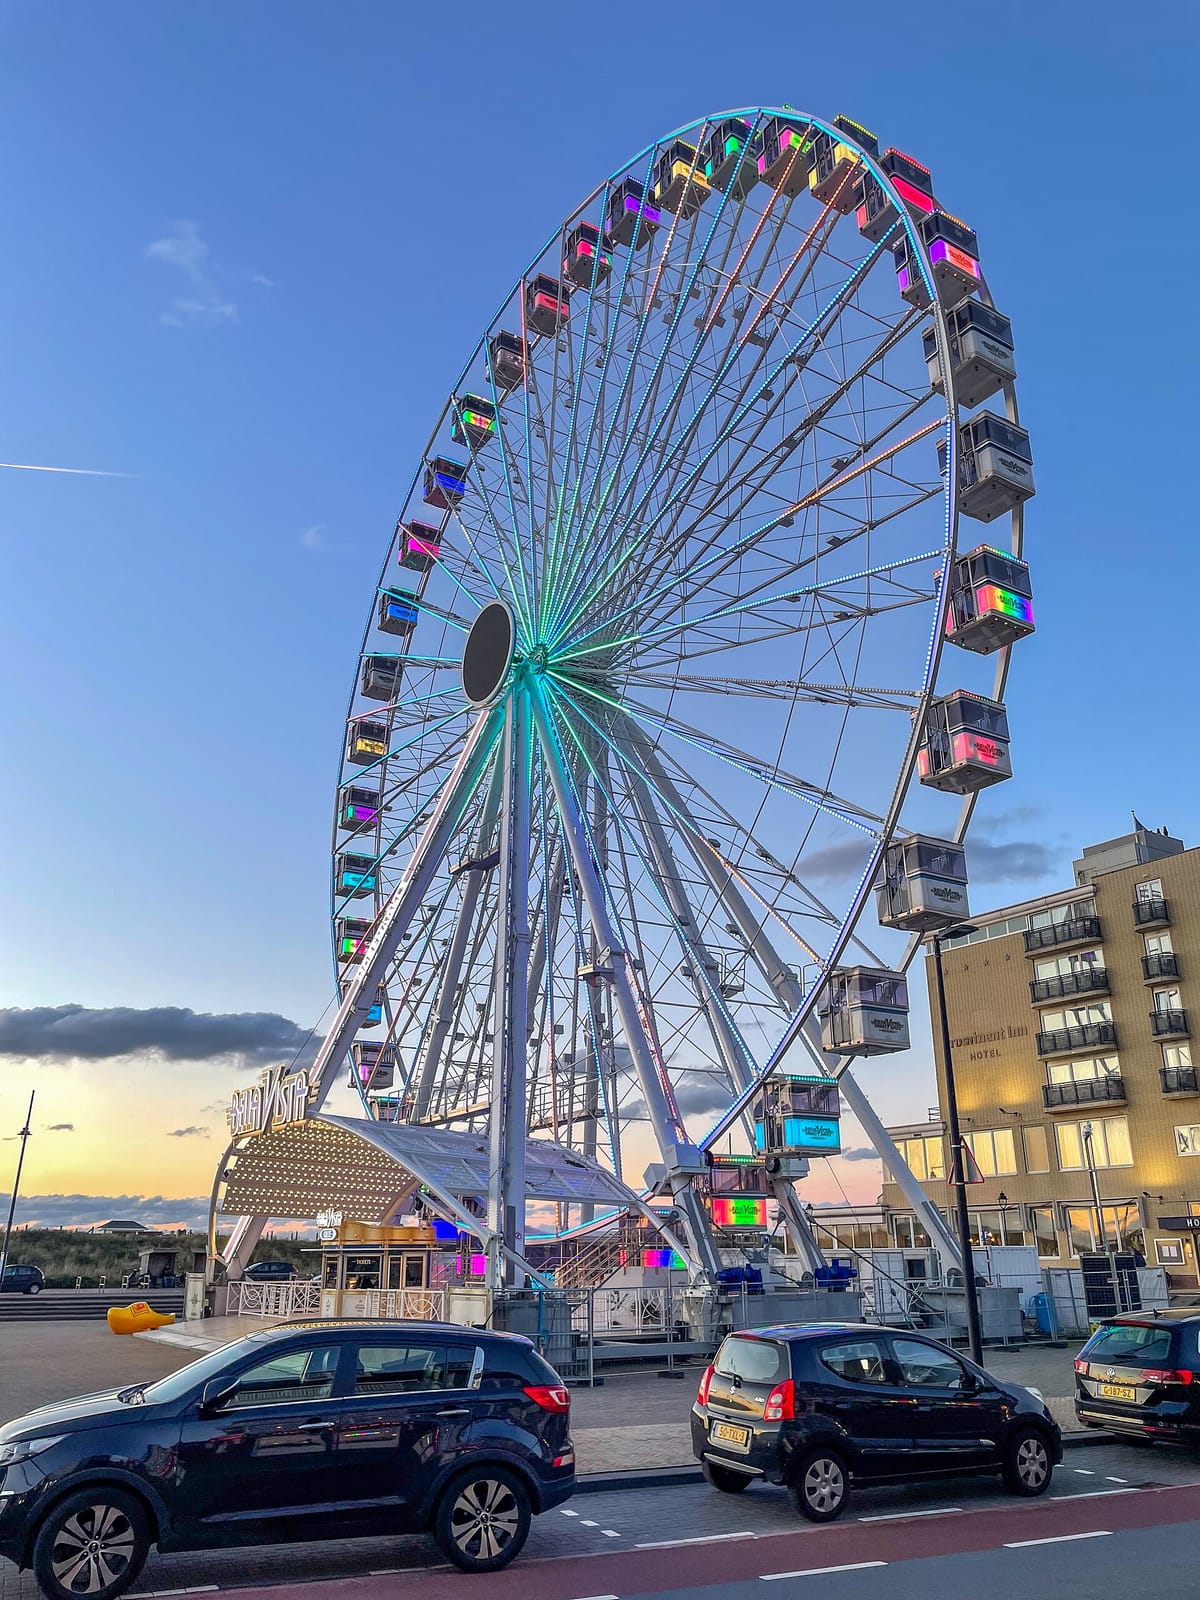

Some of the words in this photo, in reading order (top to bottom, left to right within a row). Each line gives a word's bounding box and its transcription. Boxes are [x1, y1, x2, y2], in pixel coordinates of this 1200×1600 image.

[951, 1028, 1006, 1049] rominent
[970, 1049, 1001, 1061] HOTEL
[1103, 1386, 1132, 1398] G-187-SZ
[719, 1426, 745, 1442] 50-TXL-3
